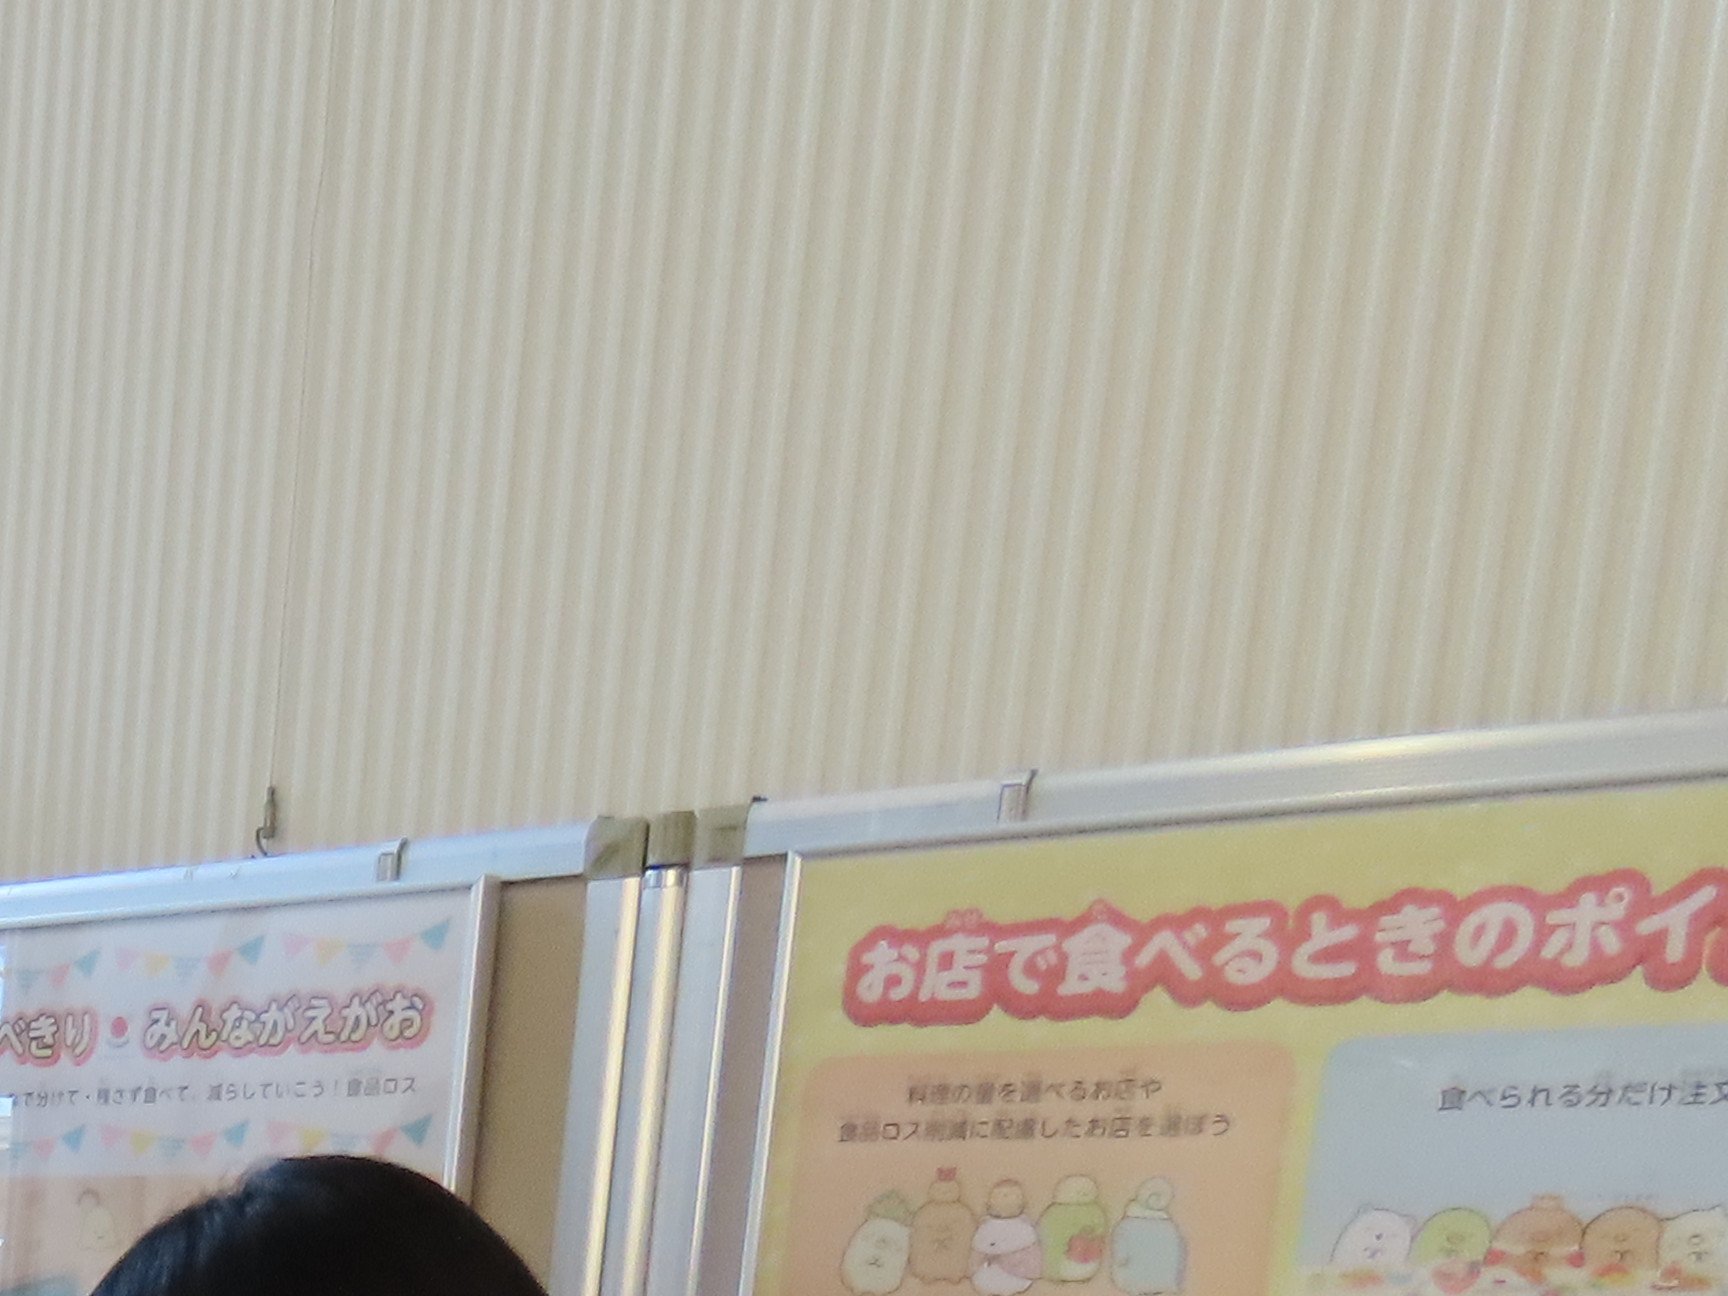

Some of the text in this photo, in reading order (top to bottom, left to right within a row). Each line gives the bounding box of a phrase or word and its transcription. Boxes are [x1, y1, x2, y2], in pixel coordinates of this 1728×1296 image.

[855, 884, 1719, 1003] お店で食べるときのポイ
[145, 990, 425, 1053] みんながえがお
